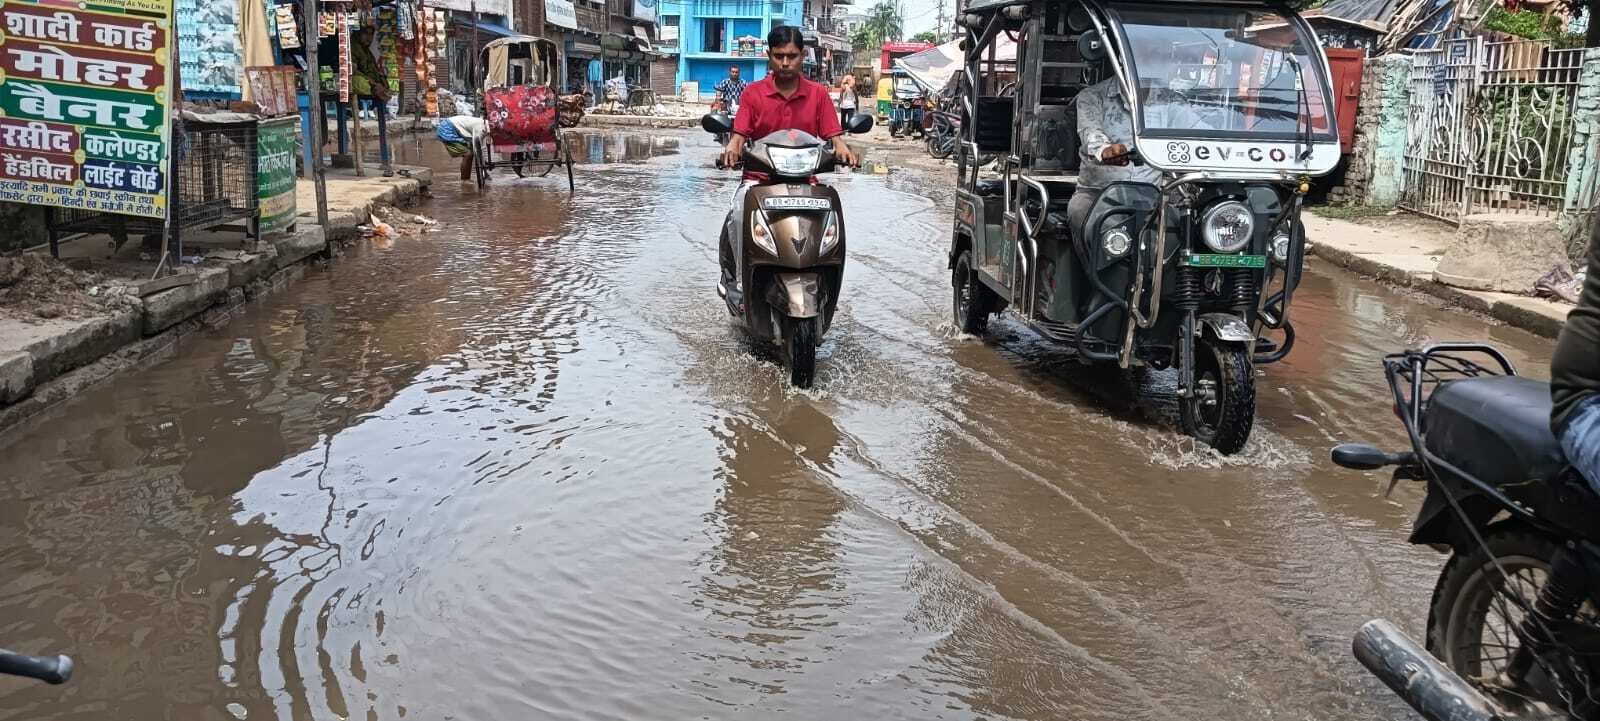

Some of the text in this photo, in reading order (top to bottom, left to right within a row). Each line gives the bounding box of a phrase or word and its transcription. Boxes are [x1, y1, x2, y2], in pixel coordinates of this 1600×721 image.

[4, 11, 156, 50] शादी कार्ड
[8, 44, 153, 90] मोहर
[7, 81, 154, 130] बैनर
[0, 122, 73, 152] रसीद
[84, 131, 160, 161] कलेण्डर
[84, 162, 125, 187] लाईट
